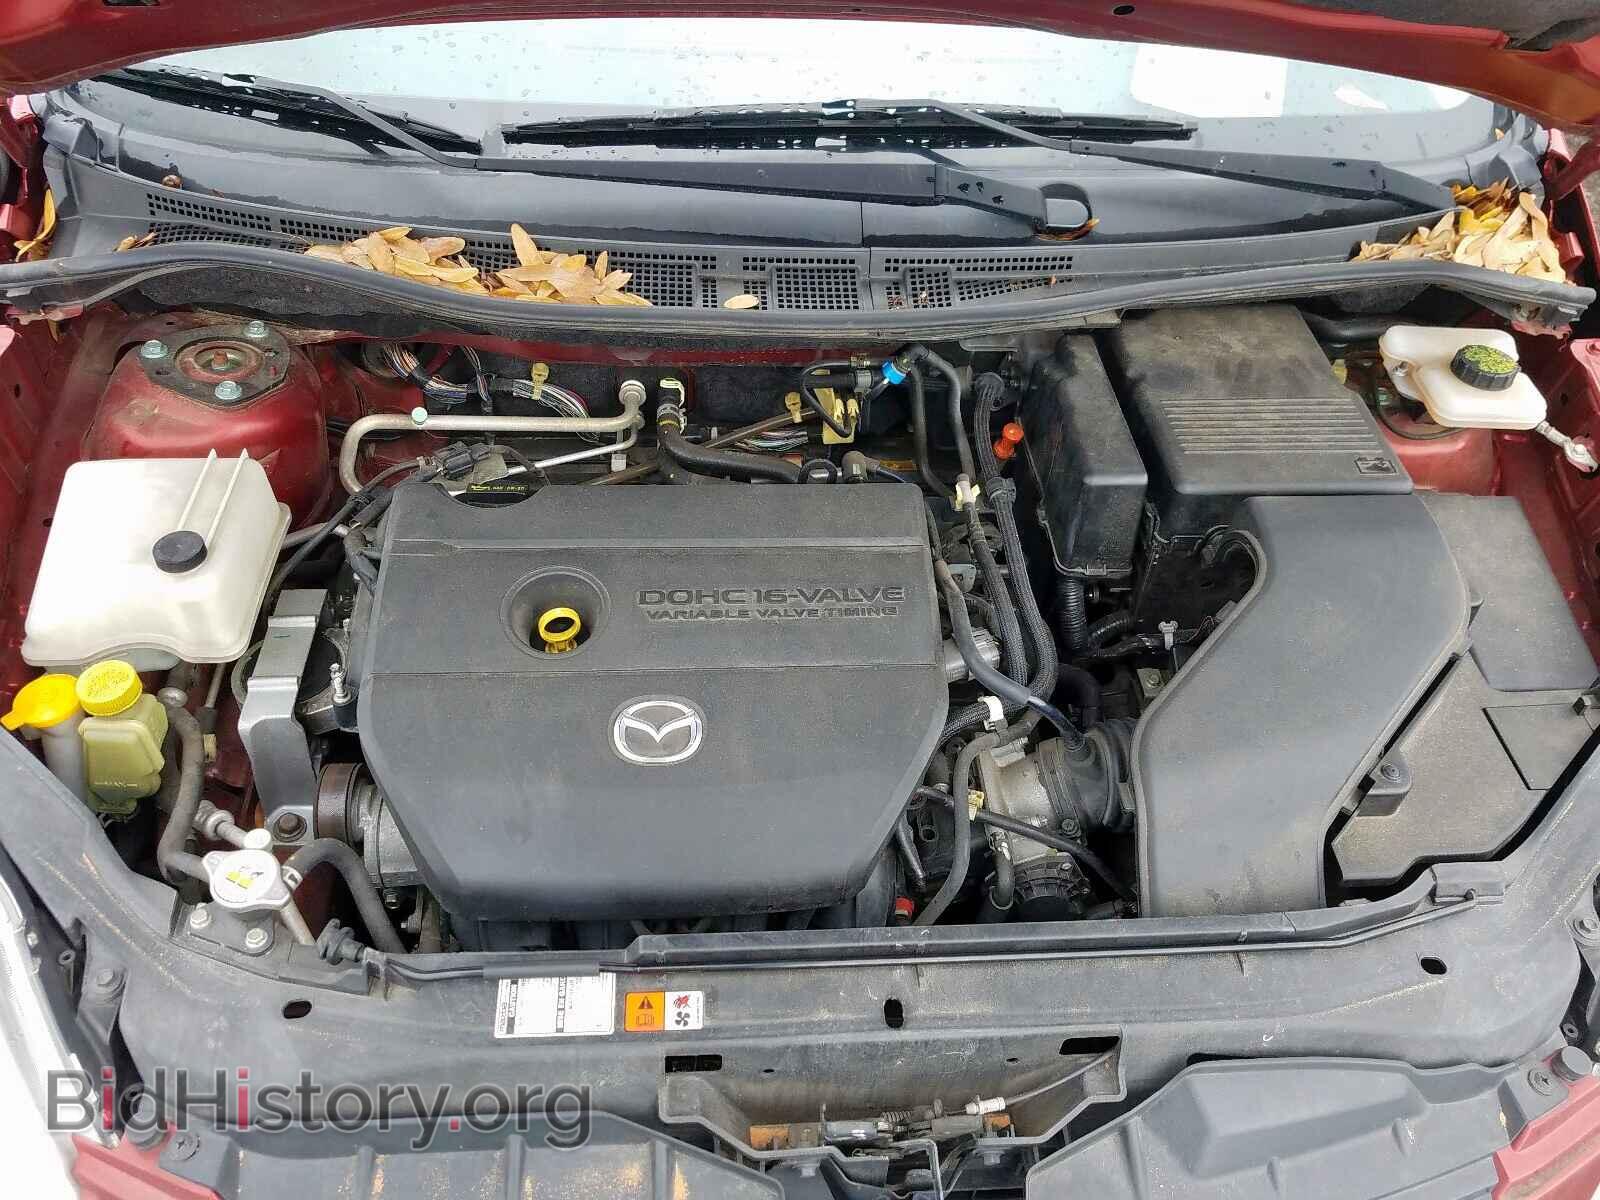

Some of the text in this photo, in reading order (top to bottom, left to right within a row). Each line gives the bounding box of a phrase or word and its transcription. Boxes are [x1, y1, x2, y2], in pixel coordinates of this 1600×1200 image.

[639, 587, 905, 604] DOHC 16-VALVE
[646, 606, 898, 620] VARIABLE VALVE TIMING
